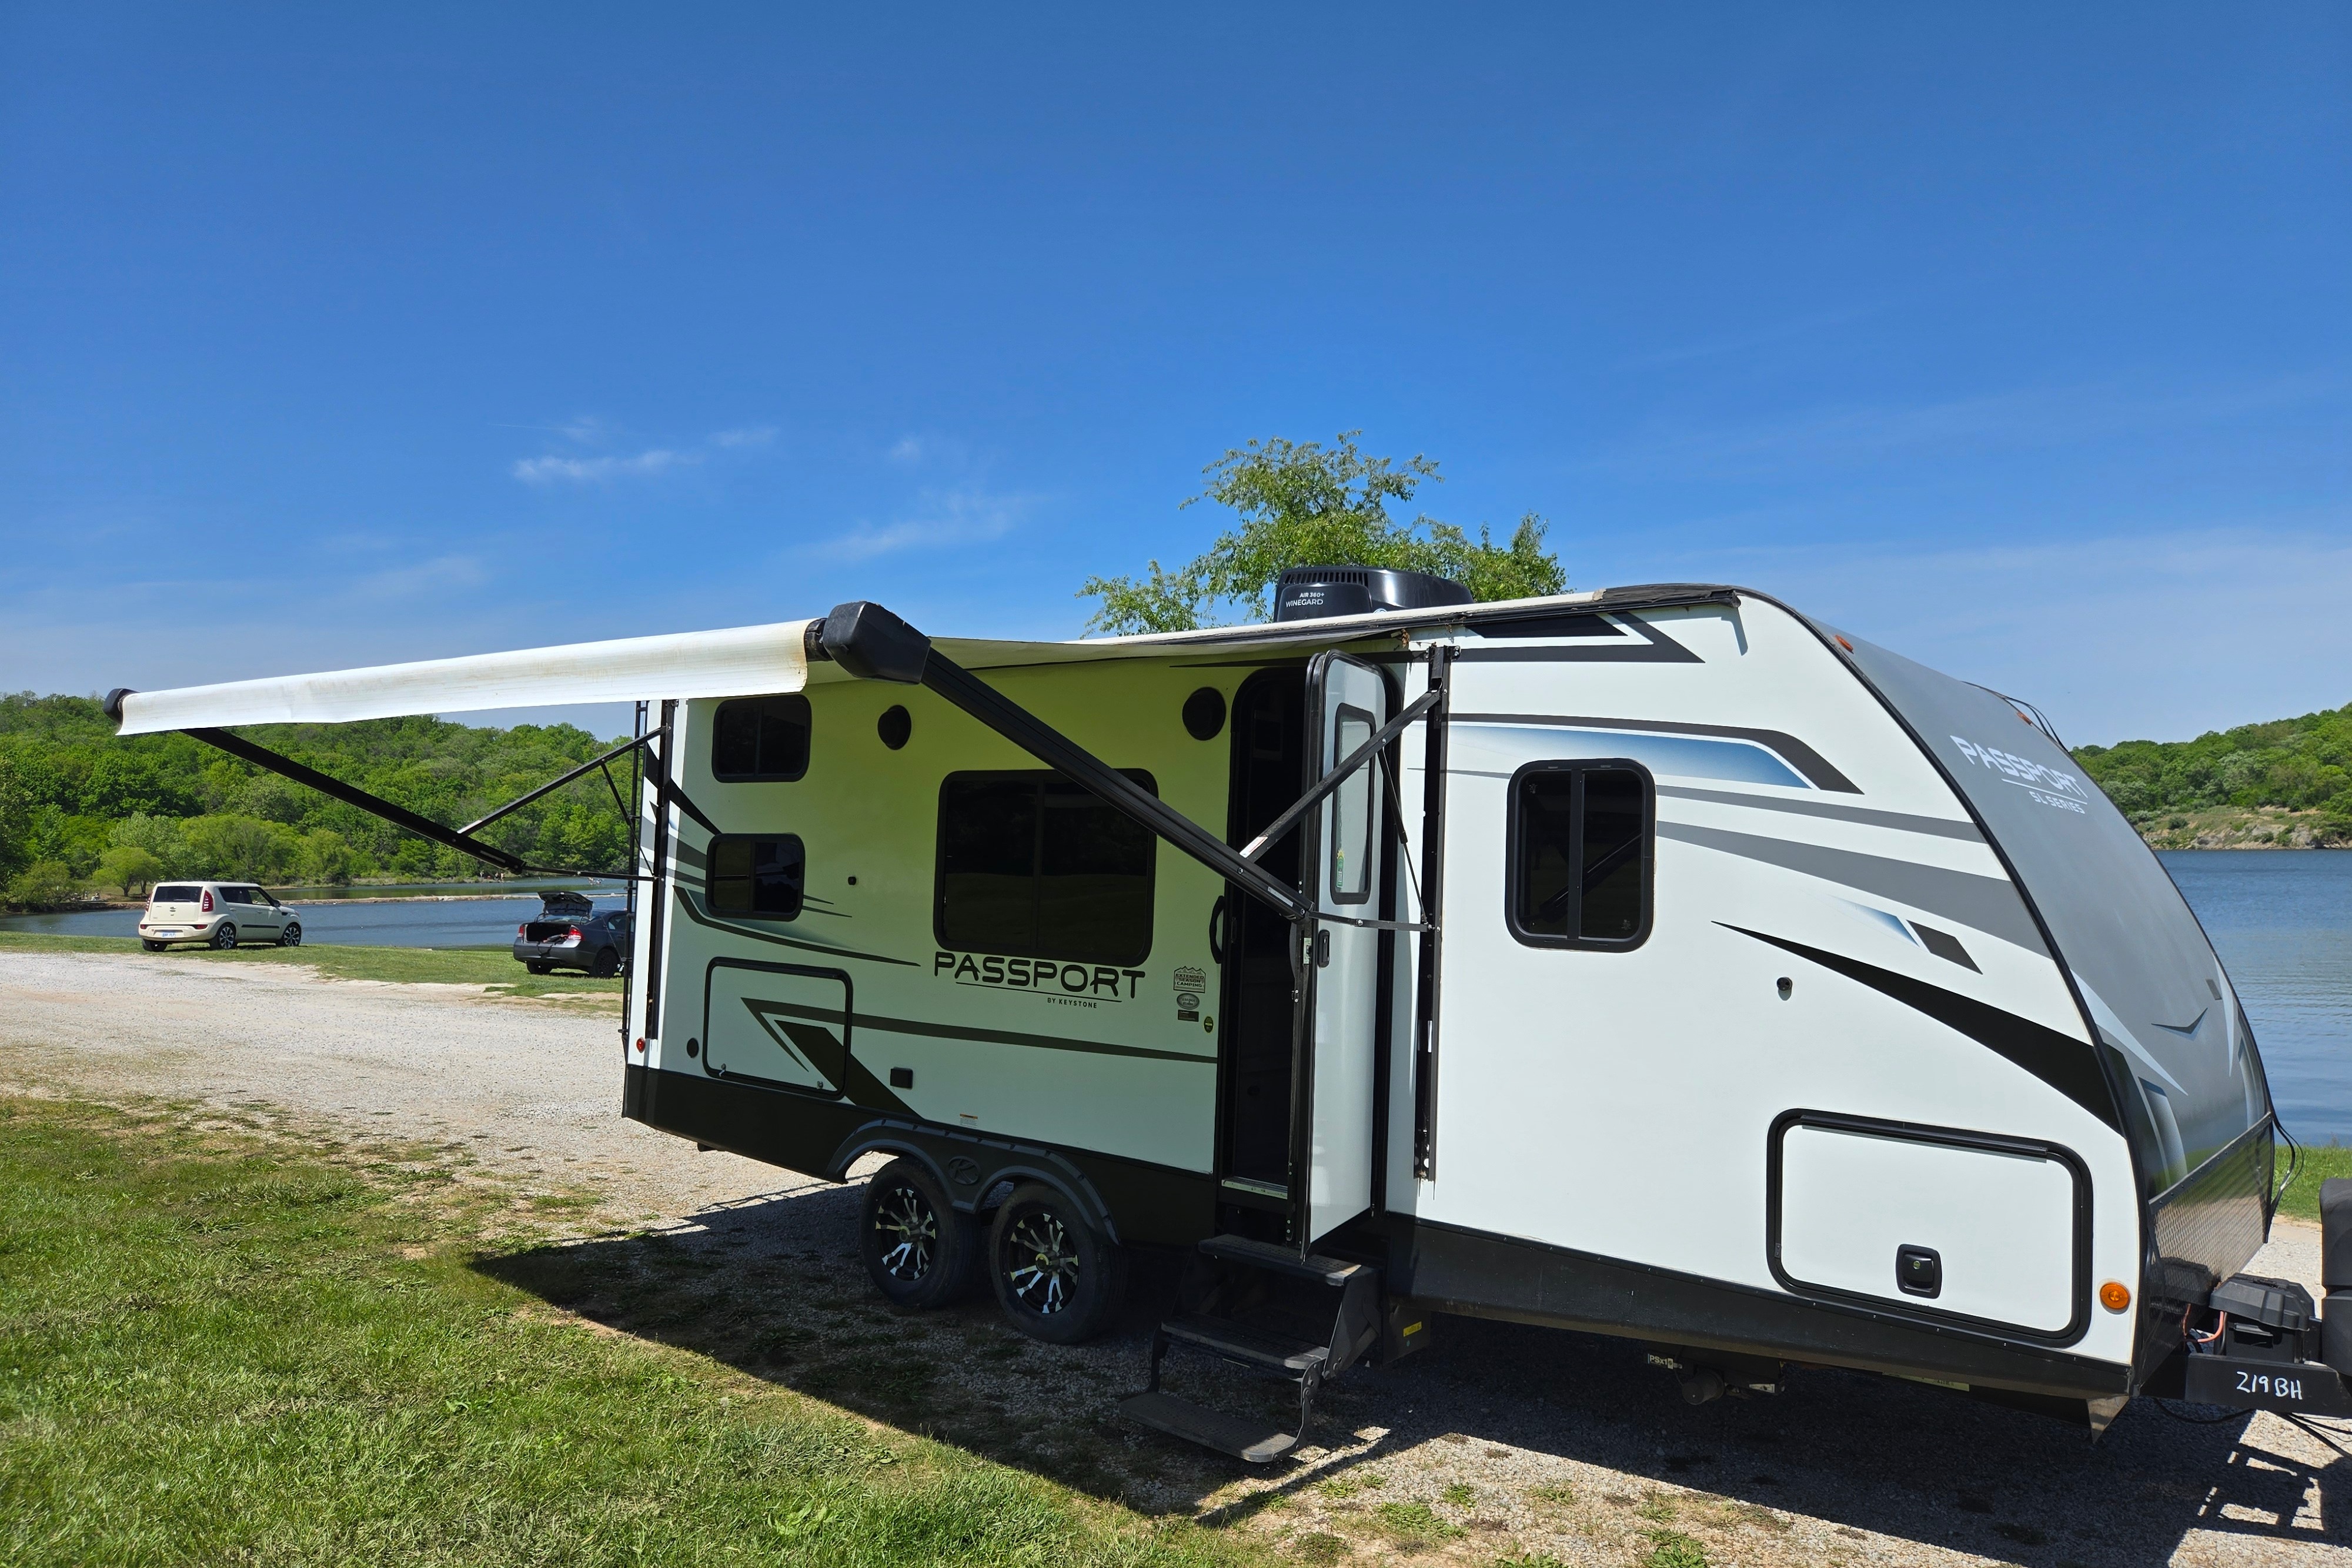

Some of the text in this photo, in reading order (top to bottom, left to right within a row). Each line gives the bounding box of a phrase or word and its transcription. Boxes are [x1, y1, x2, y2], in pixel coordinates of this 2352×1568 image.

[1286, 599, 1324, 607] WINEGARD
[1950, 735, 2088, 798] PASSPORT
[2029, 791, 2085, 814] SL SERIES
[934, 951, 1145, 998] PASSPORT
[1059, 999, 1097, 1008] KEYSTONE
